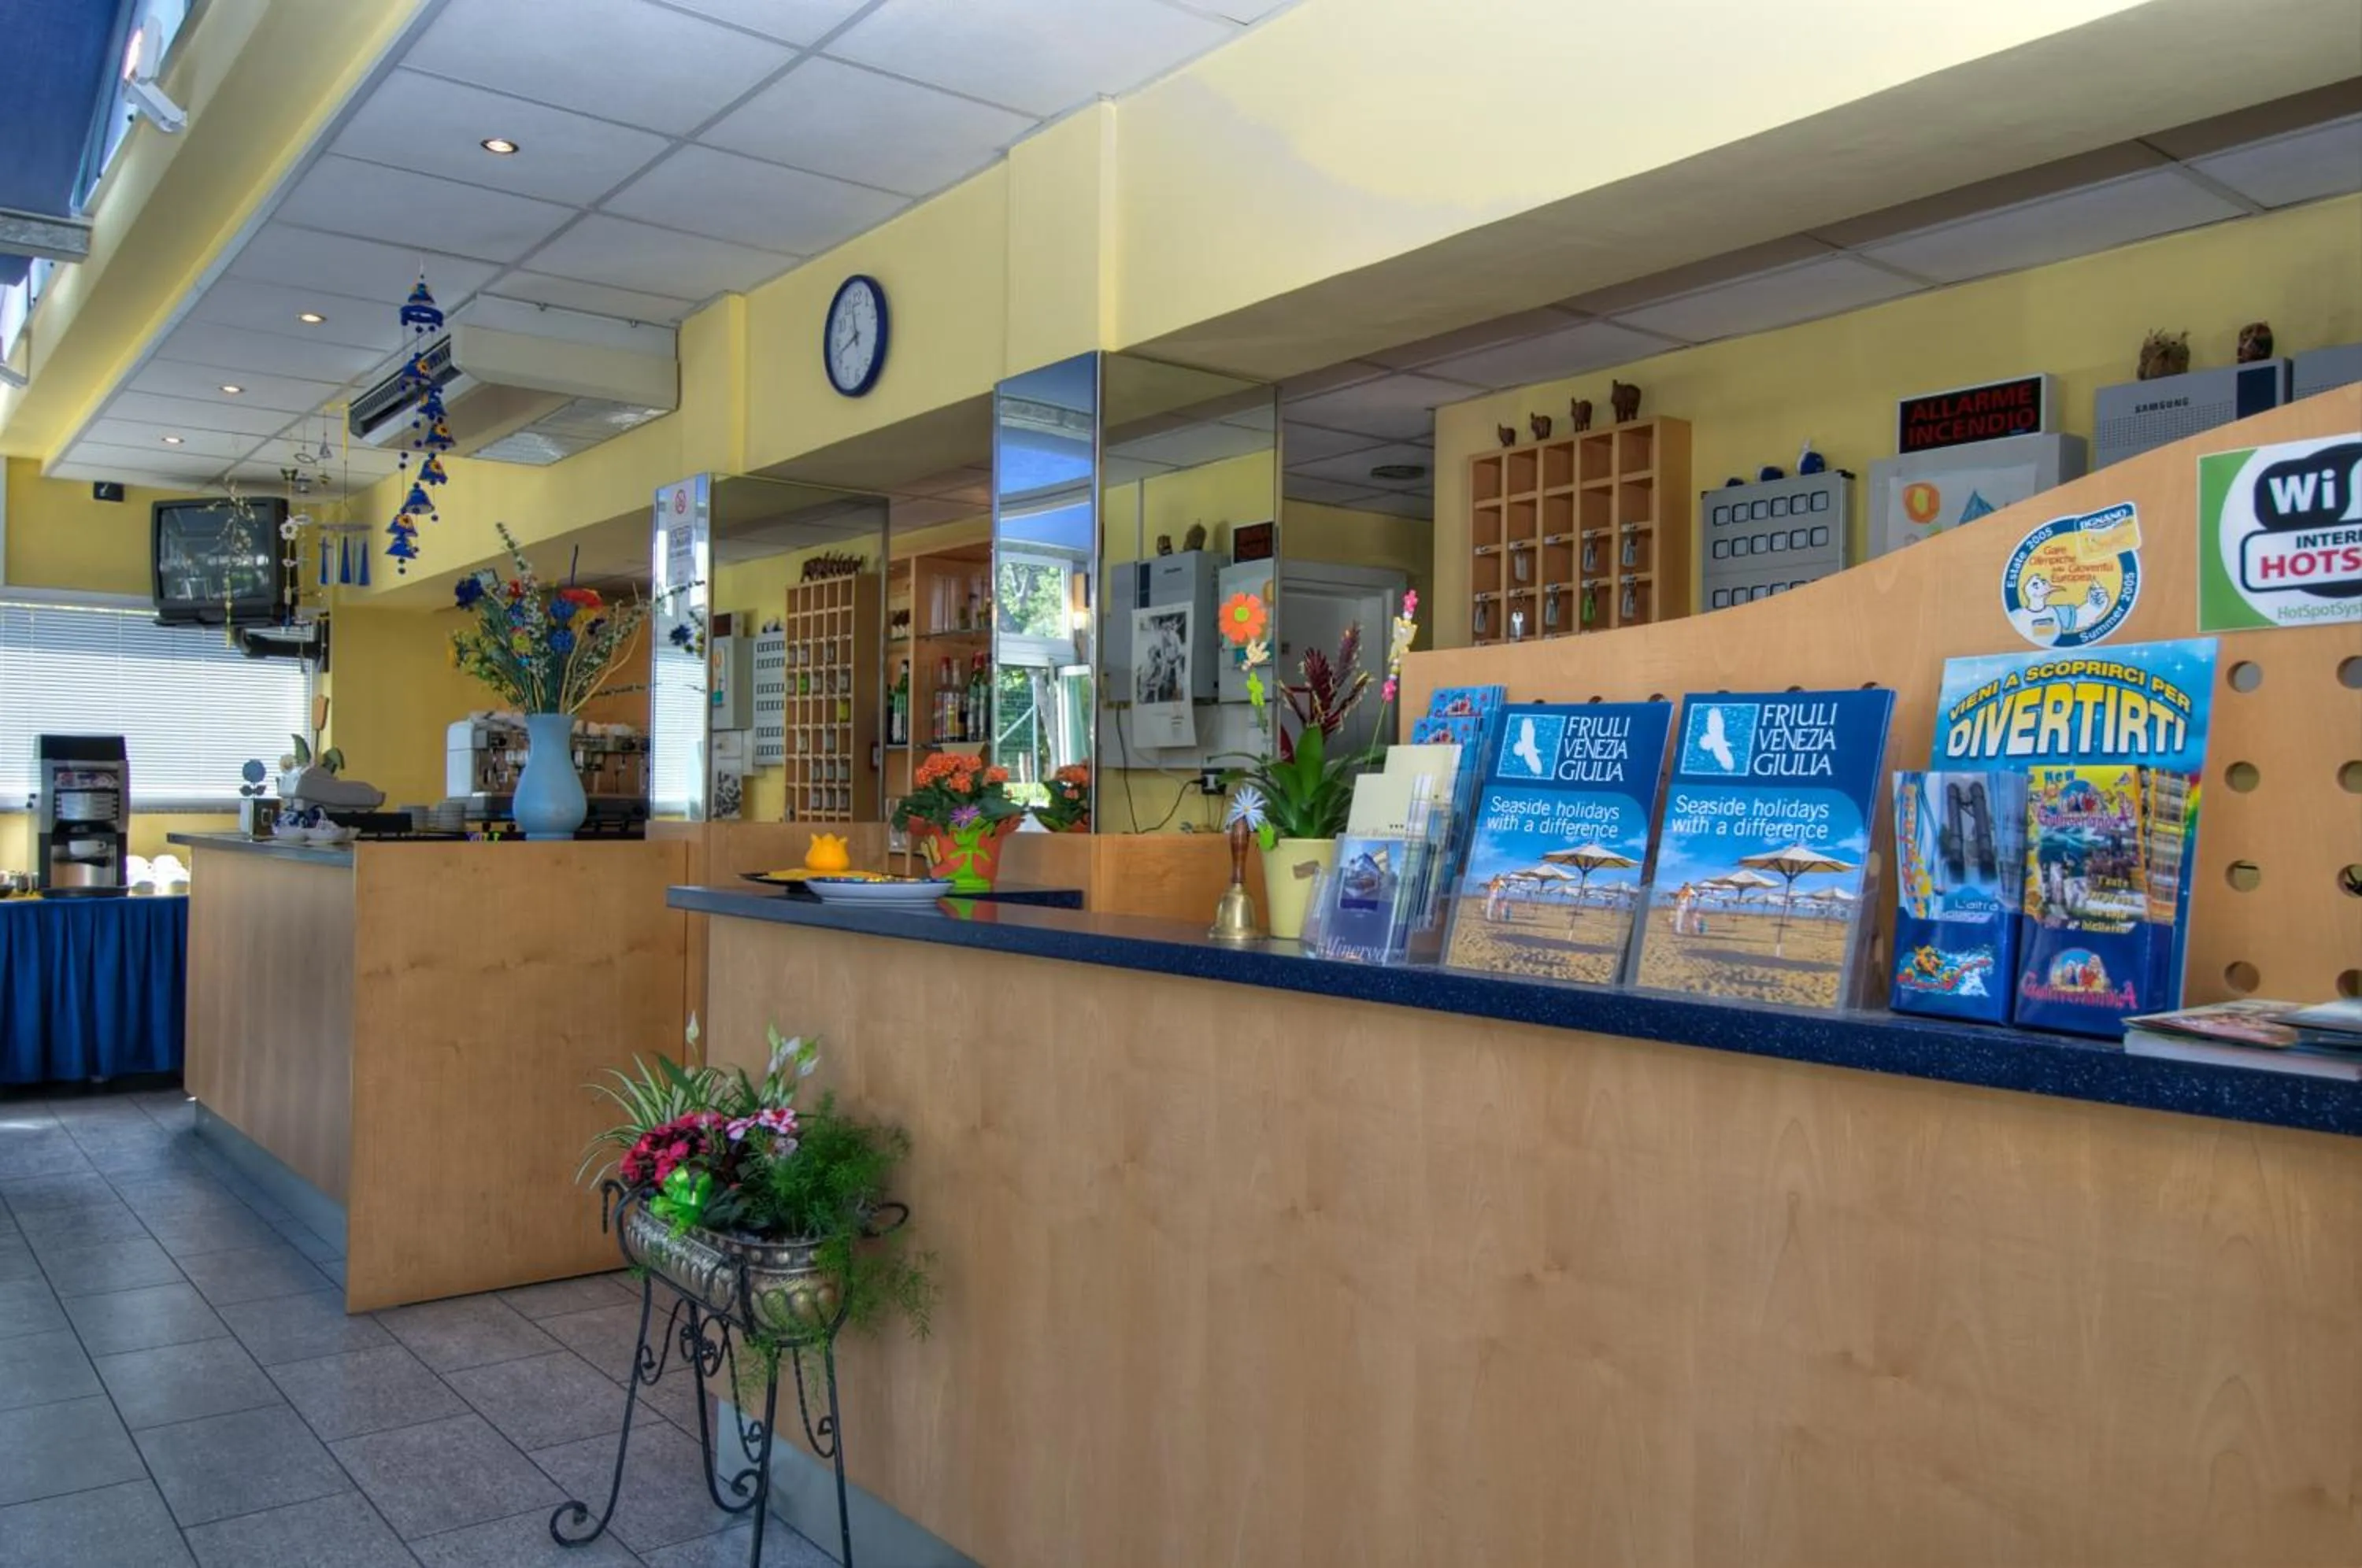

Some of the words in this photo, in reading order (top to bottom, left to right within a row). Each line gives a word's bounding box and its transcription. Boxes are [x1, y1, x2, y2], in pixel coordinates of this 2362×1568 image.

[1910, 382, 2033, 423] ALLARME
[2134, 397, 2189, 413] SAMSUNG
[1908, 407, 2036, 446] INCENDIO
[2268, 469, 2336, 515] Wi
[2008, 550, 2027, 588] Estate
[2026, 527, 2053, 549] 2005
[2079, 605, 2125, 642] Summer
[2120, 572, 2136, 603] 2005
[1949, 682, 2001, 722] VIENI
[2003, 671, 2021, 690] A
[2024, 660, 2146, 686] SCOPRIRCI
[2150, 675, 2193, 715] PER
[1567, 716, 1631, 738] FRIULI
[1762, 703, 1838, 727] FRIULI
[1946, 682, 2188, 758] DIVERTIRTI
[1564, 738, 1628, 760] VENEZIA
[1759, 727, 1837, 751] VENEZIA
[1558, 760, 1624, 782] GIULIA
[1753, 753, 1833, 775] GIULIA
[1490, 795, 1551, 816] Seaside
[1557, 801, 1620, 823] holidays
[1675, 794, 1747, 816] Seaside
[1753, 797, 1830, 823] holidays
[1486, 812, 1519, 832] with
[1523, 819, 1534, 832] a
[1539, 816, 1619, 839] difference
[1672, 813, 1710, 834] with
[1716, 821, 1727, 836] a
[1733, 817, 1829, 840] difference
